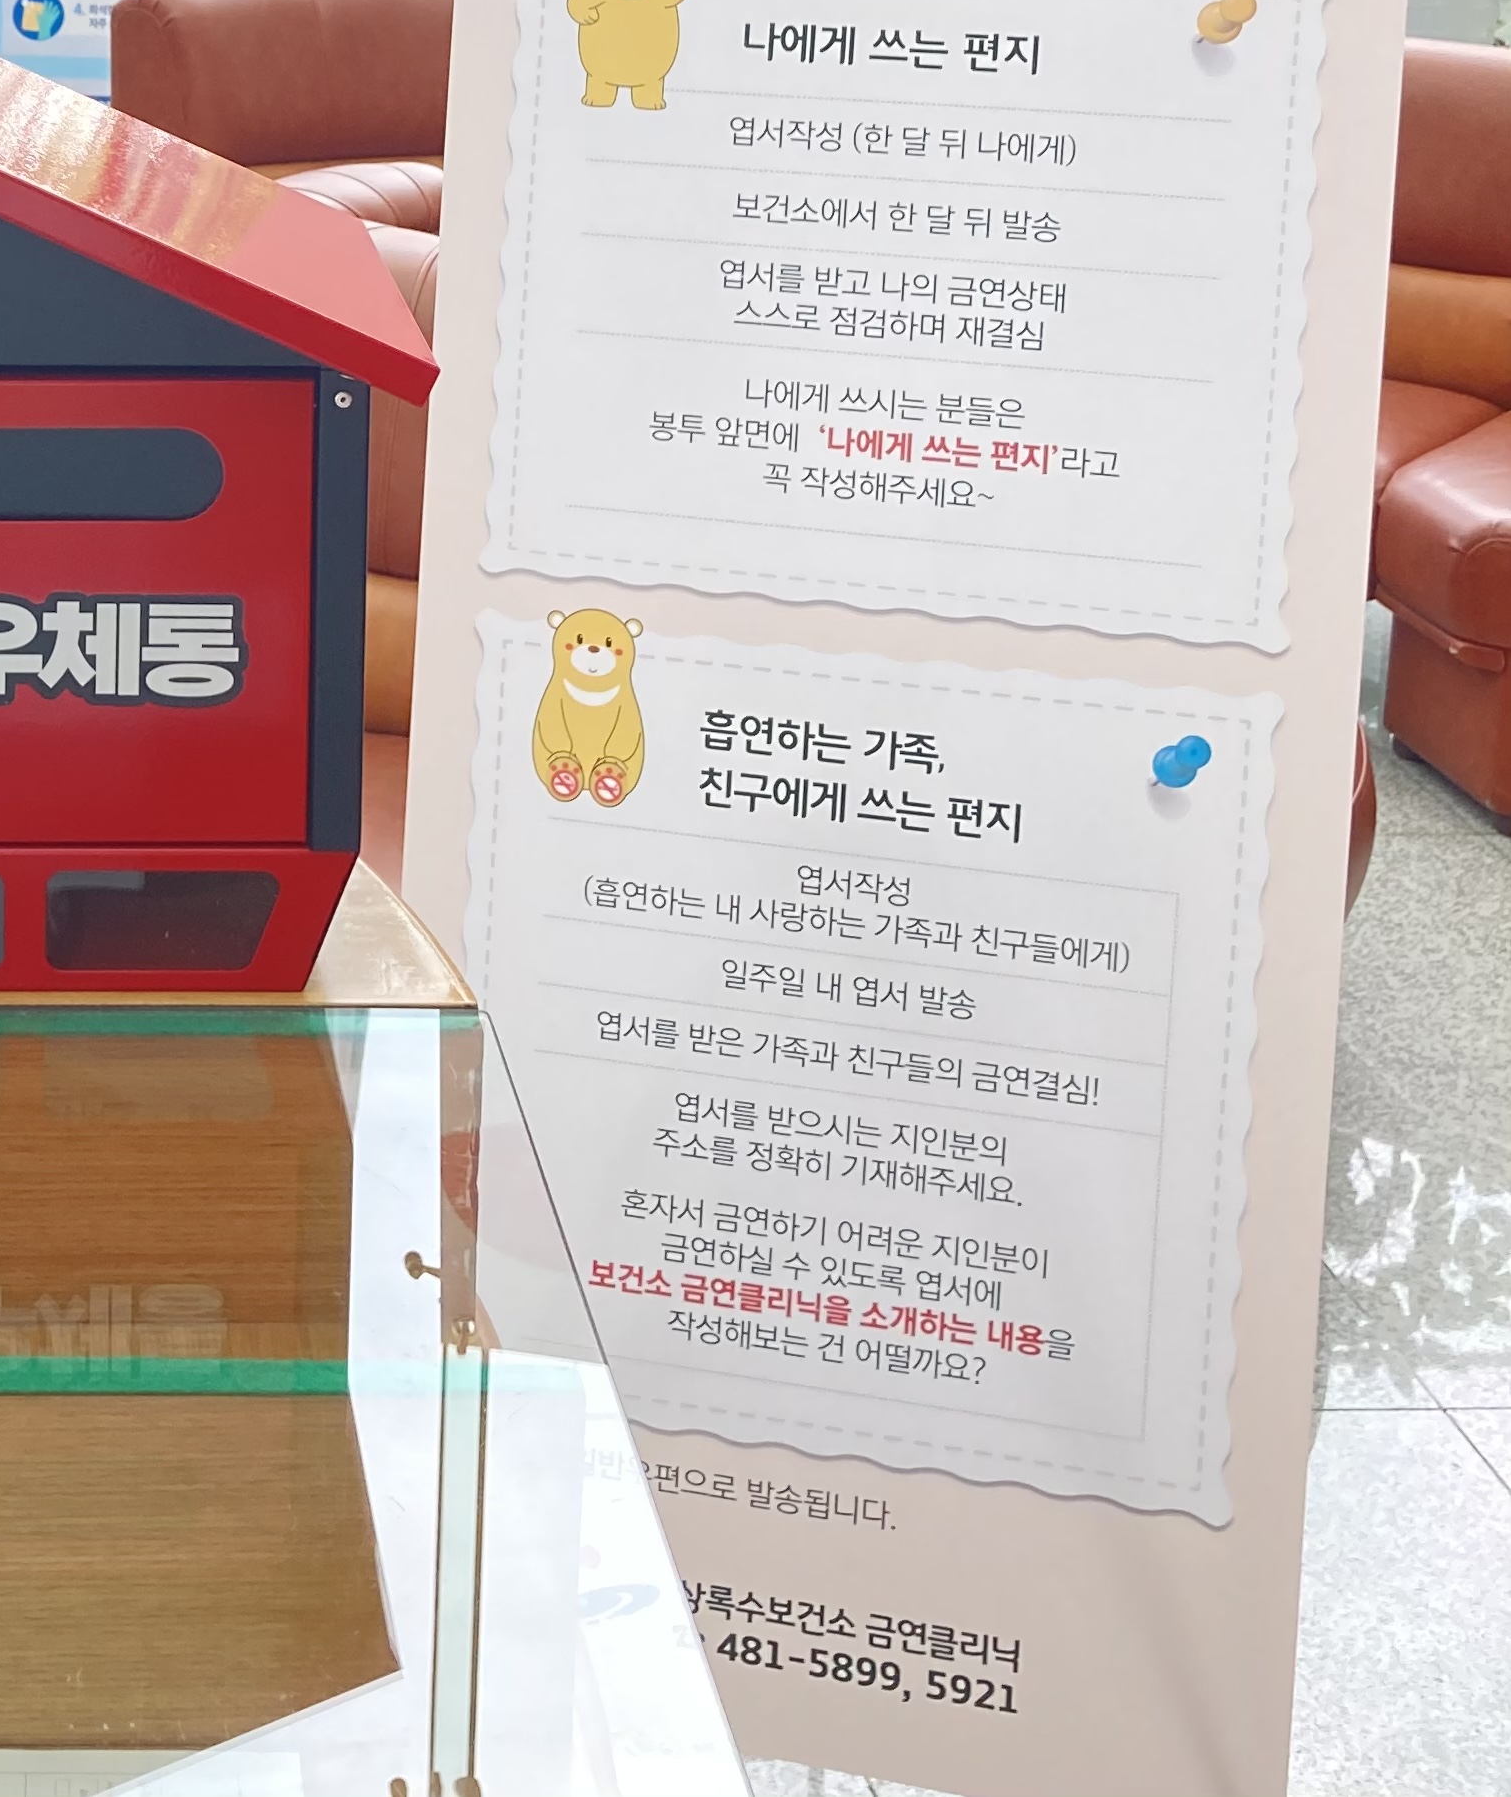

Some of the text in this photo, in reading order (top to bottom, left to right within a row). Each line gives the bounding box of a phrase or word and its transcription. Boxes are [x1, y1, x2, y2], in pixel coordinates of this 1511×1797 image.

[743, 22, 1040, 76] 나에게 쓰는 편지
[729, 115, 1076, 167] 엽서작성 (한 달 뒤 나에게)
[720, 258, 1067, 314] 엽서를 받고 나의 금연상태
[733, 300, 1044, 352] 스스로 점검하며 재결심
[745, 378, 1026, 431] 나에게 쓰시는 분들은
[649, 410, 706, 444] 봉투
[715, 416, 799, 453] 앞면에
[921, 434, 982, 469] 쓰는
[762, 462, 792, 495] 꼭
[699, 709, 945, 775] 흡연하는 가족,
[699, 767, 1022, 844] 친구에게 쓰는 편지
[797, 864, 911, 908] 엽서작성
[584, 875, 1130, 974] (흡연하는 내 사랑하는 가족과 친구들에게)
[652, 1127, 1023, 1207] 주소를 정확히 기재해주세요.
[620, 1189, 1049, 1279] 혼자서 금연하기 어려운 지인분이
[588, 1259, 1076, 1362] 보건소 금연클리닉을 소개하는 내용을
[667, 1310, 987, 1385] 작성해보는 건 어떨까요?
[747, 1479, 897, 1531] 발송됩니다.
[865, 1613, 1021, 1672] 금연클리닉
[716, 1633, 1018, 1715] 481-5899, 5921
